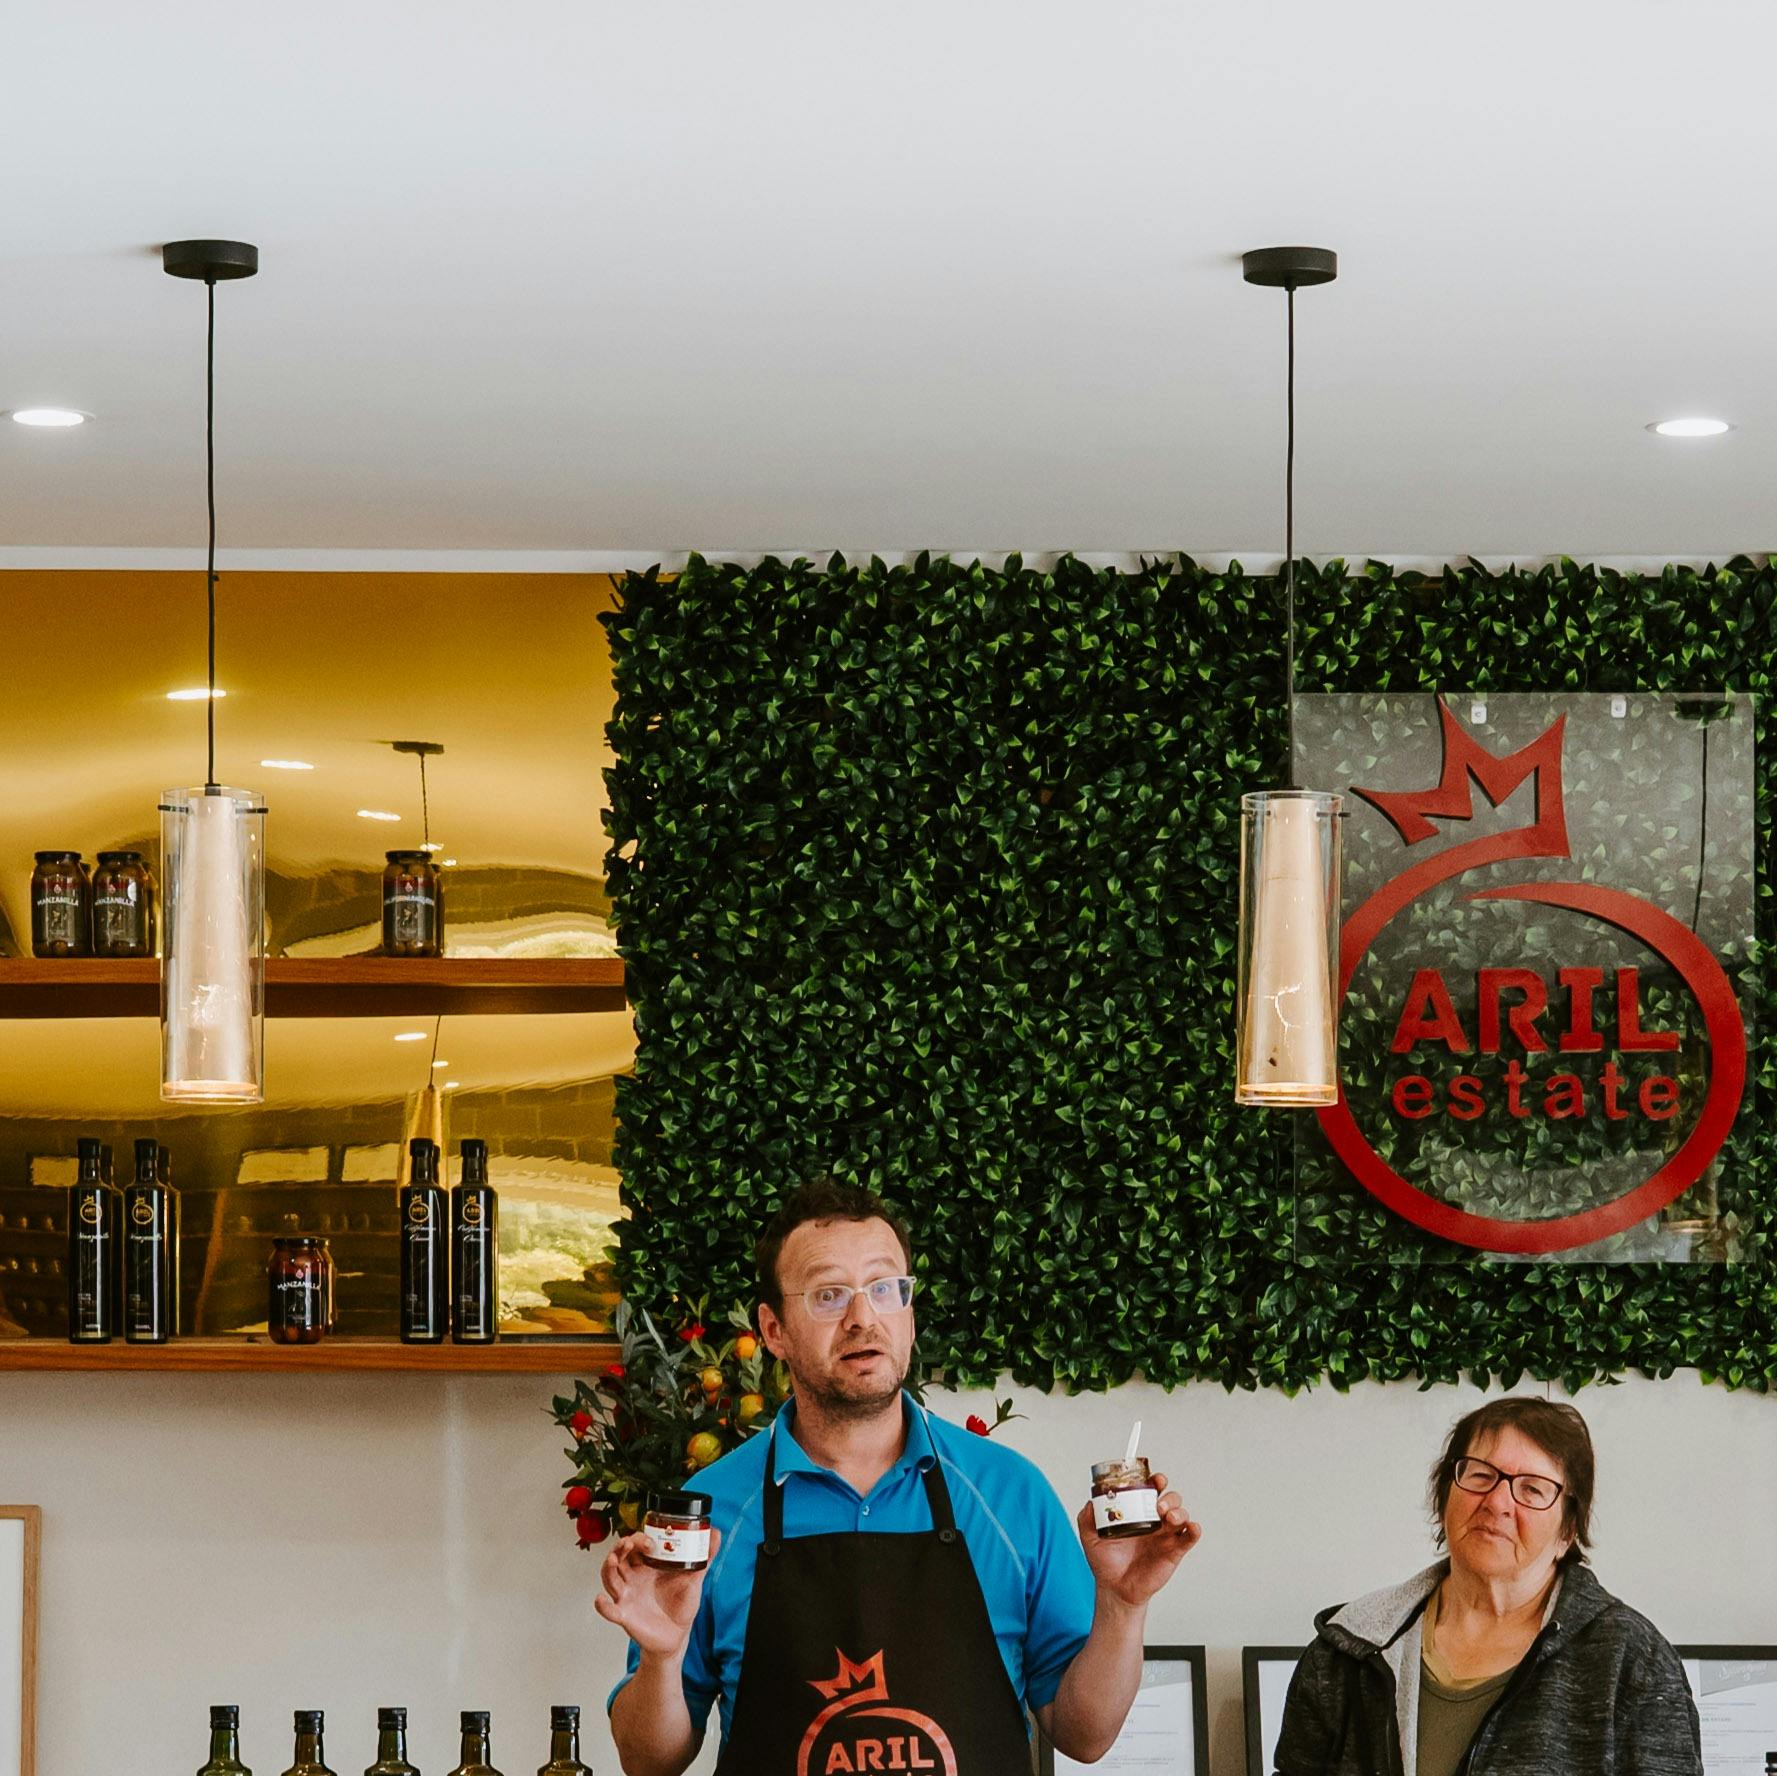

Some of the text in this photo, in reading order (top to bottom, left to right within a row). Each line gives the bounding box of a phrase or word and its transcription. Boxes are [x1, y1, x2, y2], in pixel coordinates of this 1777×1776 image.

[1390, 967, 1681, 1054] ARIL
[1391, 1059, 1682, 1120] estate
[825, 1736, 935, 1775] ARIL
